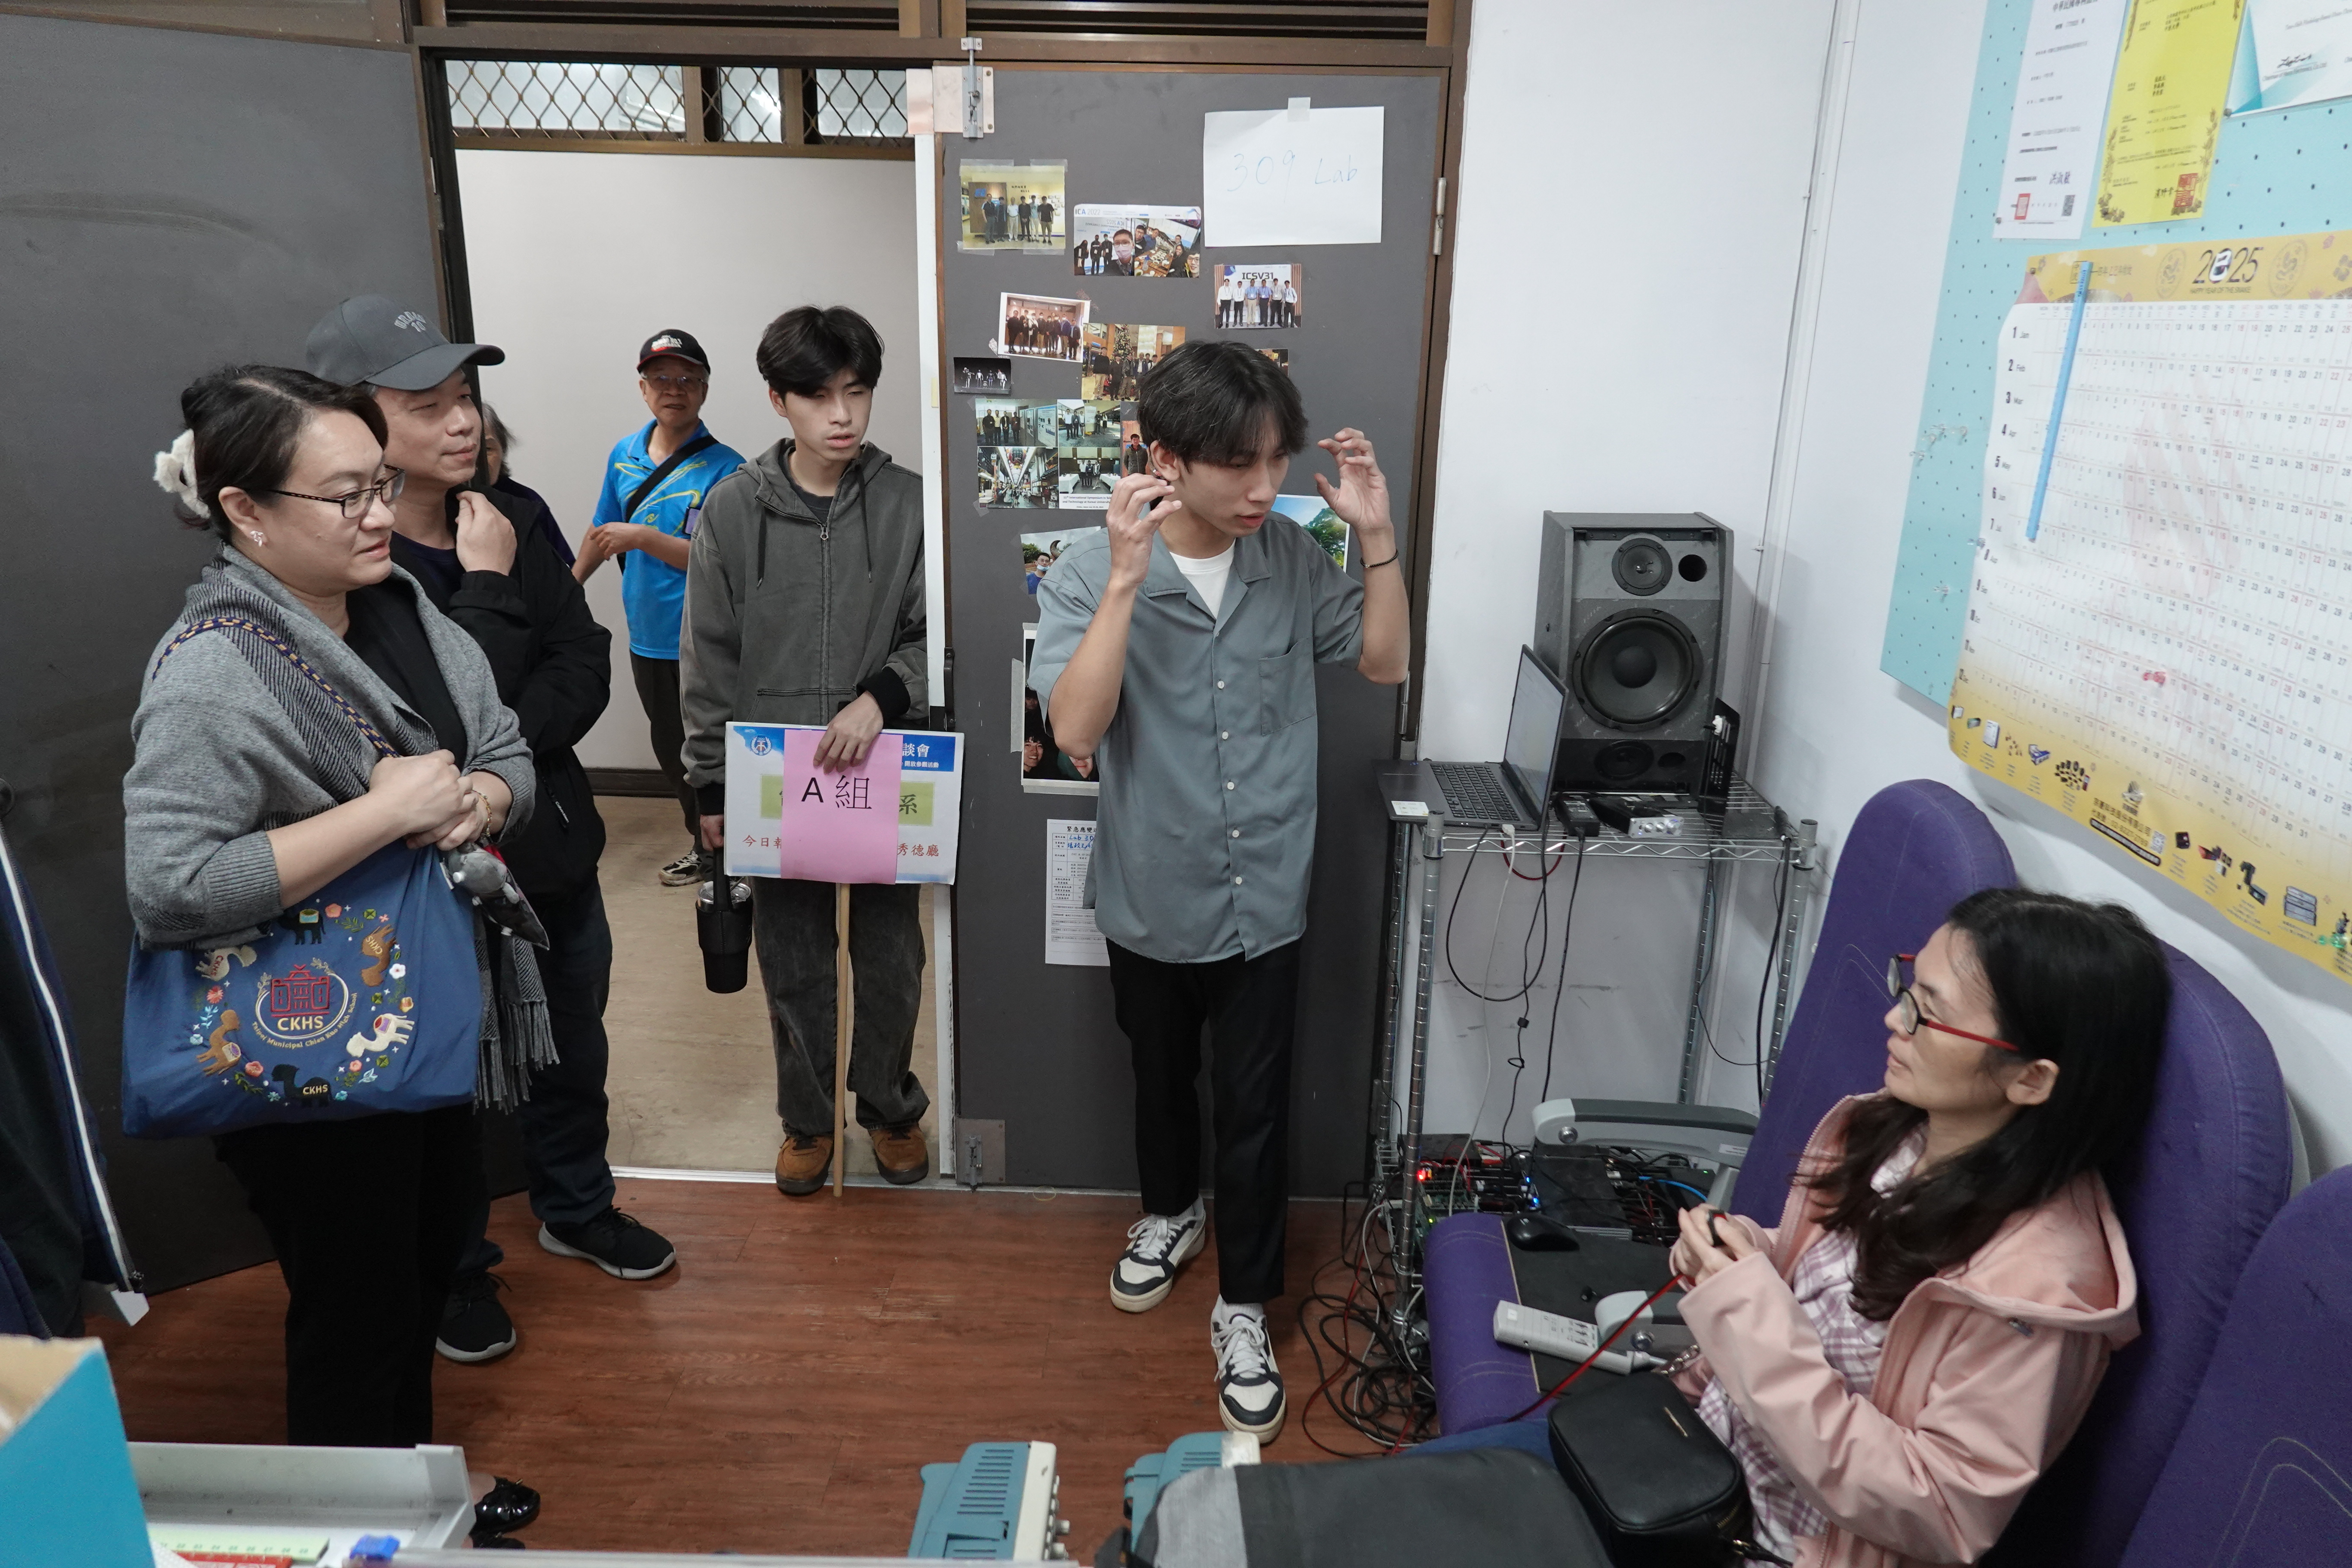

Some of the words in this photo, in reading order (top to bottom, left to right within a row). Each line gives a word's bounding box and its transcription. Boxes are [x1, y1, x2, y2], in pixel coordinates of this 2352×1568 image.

[1227, 150, 1295, 204] 309
[1315, 154, 1357, 184] Lab
[2192, 247, 2263, 284] 2025
[2013, 326, 2017, 338] 1
[2008, 359, 2014, 371] 2
[2006, 392, 2011, 403] 3
[2002, 424, 2007, 435] 4
[1995, 456, 2001, 467] 5
[1992, 487, 1997, 499] 6
[366, 935, 383, 955] CKHS
[211, 955, 224, 977] CKHS
[252, 1021, 267, 1041] Taipei
[266, 1038, 303, 1050] Municipal
[305, 1036, 325, 1046] Chien
[325, 1028, 338, 1039] Kuo
[338, 1015, 350, 1028] High
[348, 992, 358, 1013] School
[277, 1016, 323, 1031] CKHS
[303, 1084, 328, 1095] CKHS
